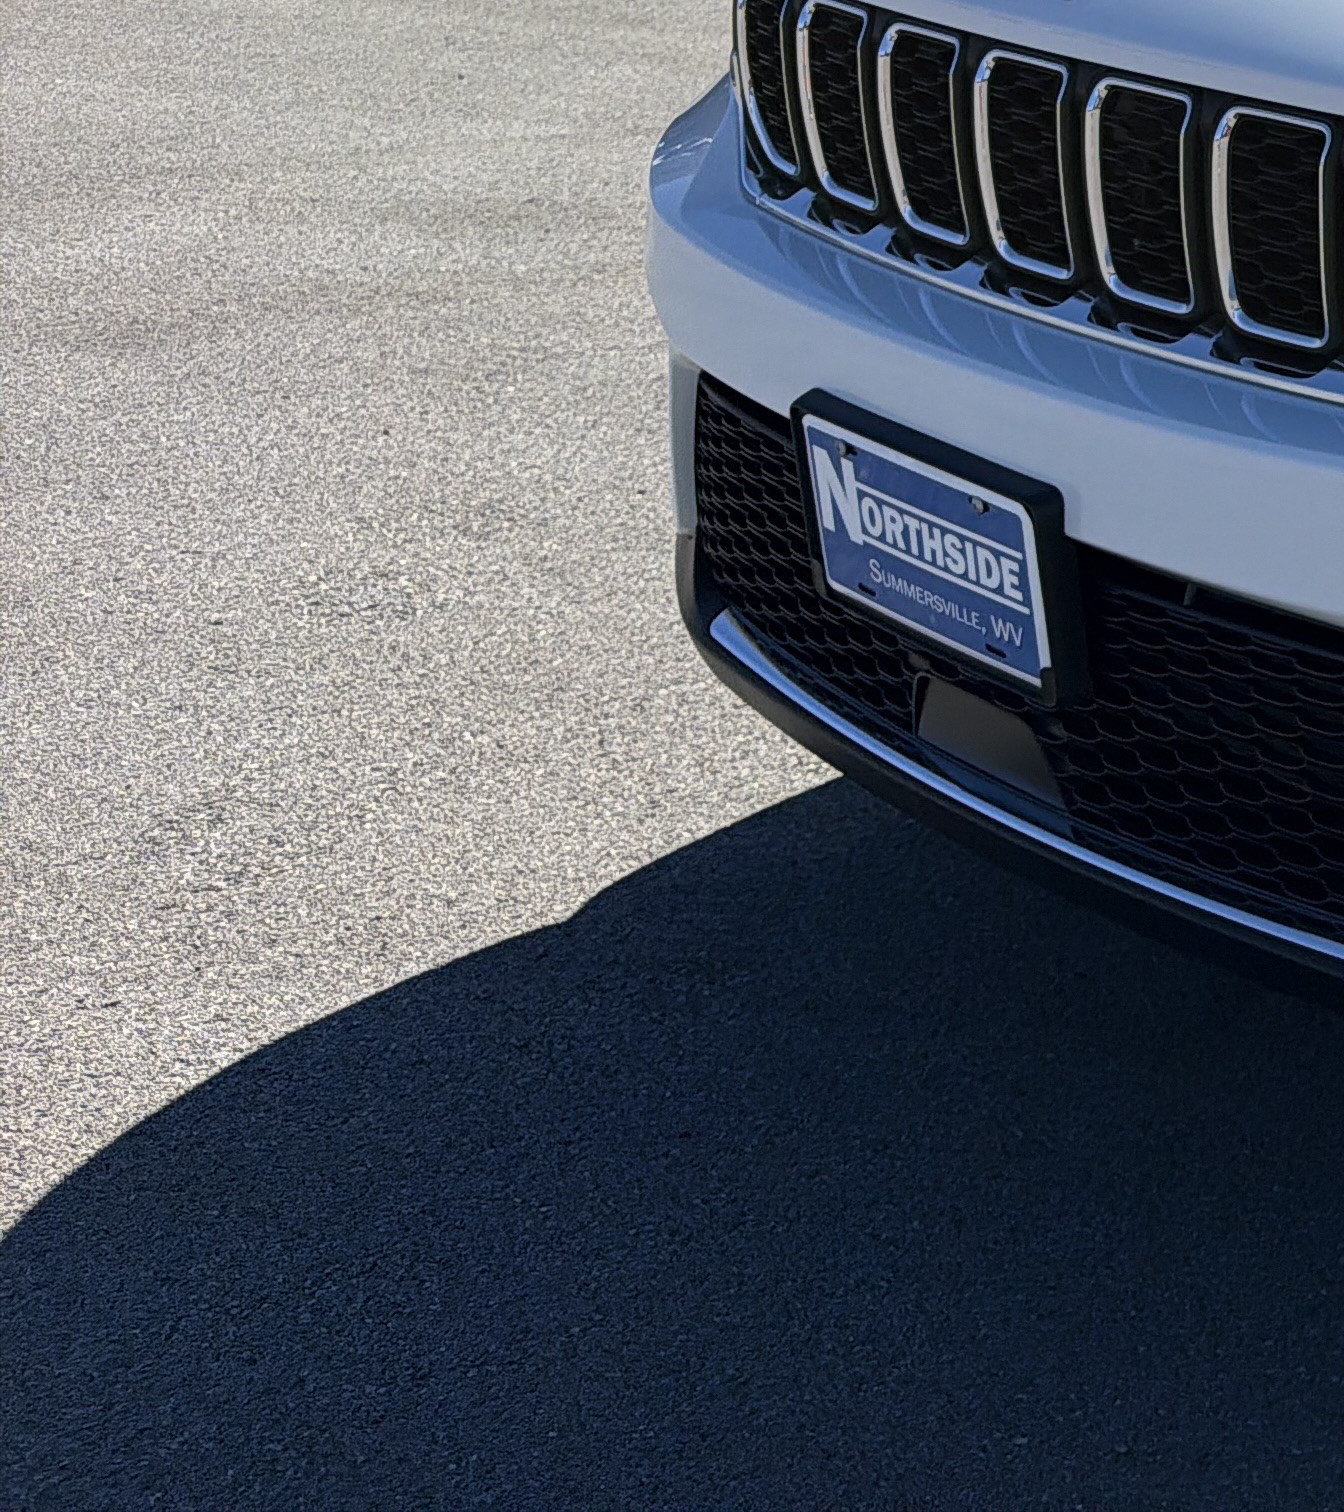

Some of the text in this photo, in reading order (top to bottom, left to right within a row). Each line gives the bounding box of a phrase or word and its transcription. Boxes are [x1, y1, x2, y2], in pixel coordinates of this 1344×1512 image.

[812, 445, 1024, 602] NORTHSIDE
[869, 558, 1023, 647] SUMMERSVILLE, WV
